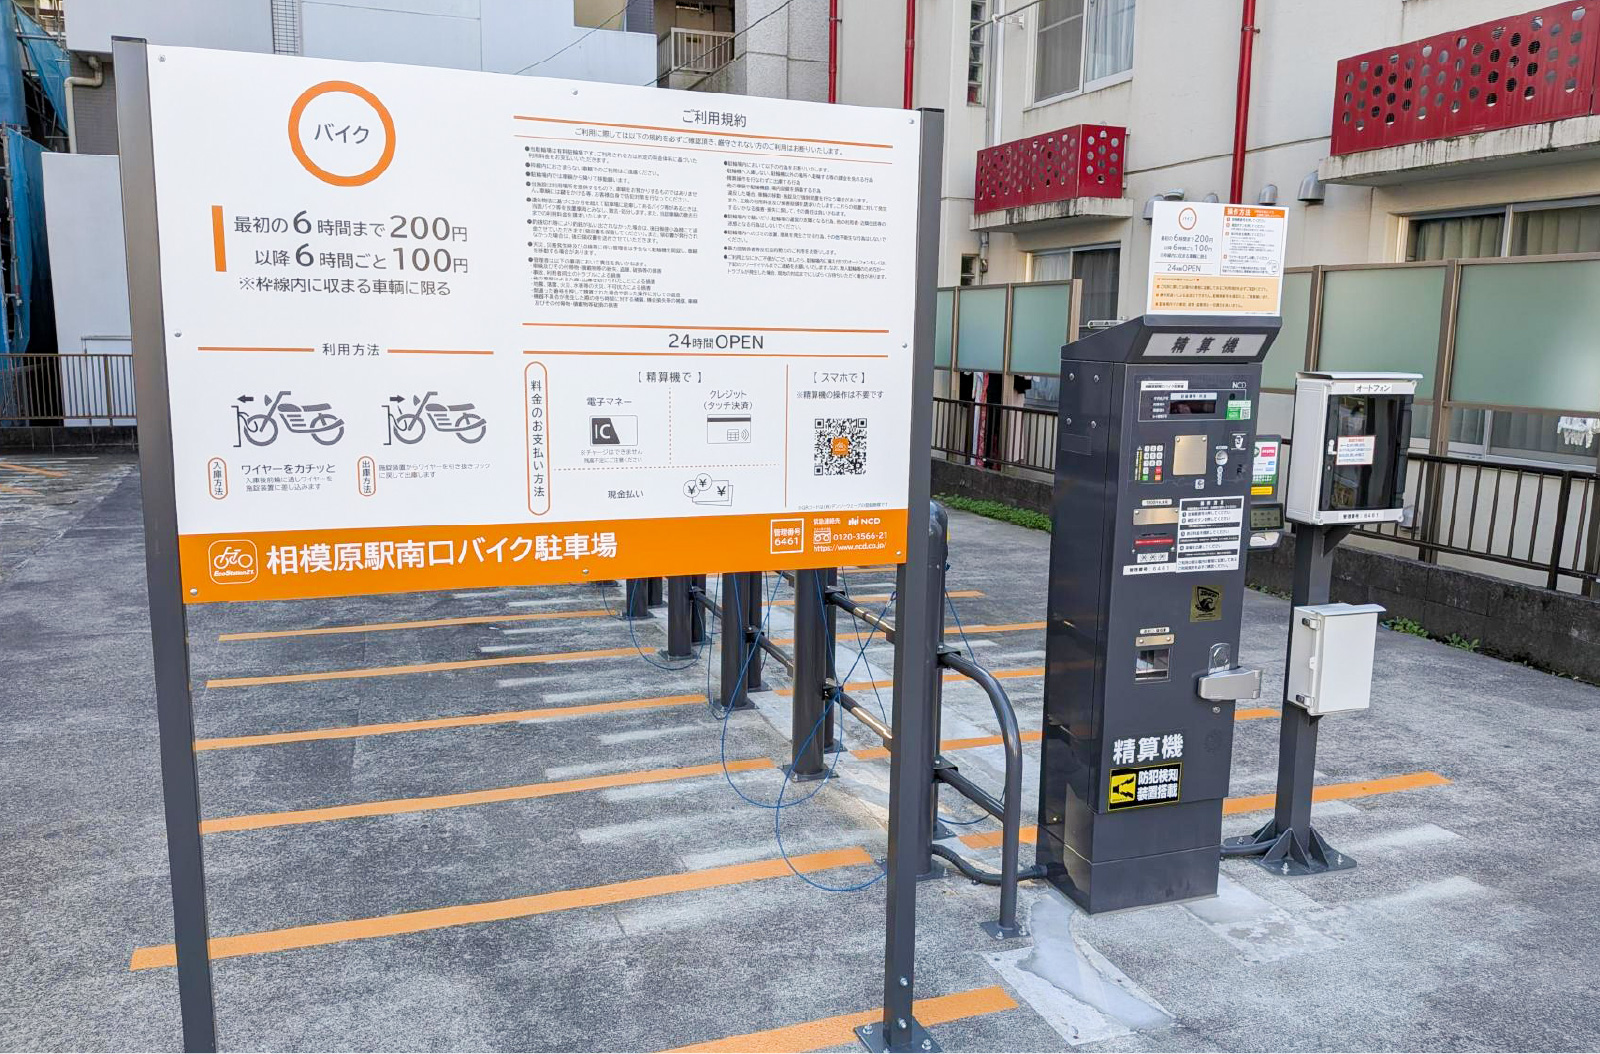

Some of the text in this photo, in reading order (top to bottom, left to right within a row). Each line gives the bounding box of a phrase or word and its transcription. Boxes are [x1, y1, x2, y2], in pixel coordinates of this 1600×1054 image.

[682, 109, 747, 128] ご利用規約
[314, 122, 370, 145] バイク
[233, 209, 468, 242] 最初の6時間まで200円
[254, 243, 469, 274] 以降6時間ごと100円
[321, 343, 380, 357] 利用方法
[668, 333, 764, 350] 24時間OPEN
[1171, 336, 1240, 354] 精算機
[709, 389, 747, 400] クレジット
[1355, 384, 1391, 393] オートフォン
[586, 396, 632, 407] 電子マネー
[530, 379, 545, 498] 料金のお支払い方法
[241, 464, 336, 475] ワイヤーをカチッと
[361, 460, 373, 495] 出庫方法
[212, 461, 224, 497] 入庫方法
[608, 489, 644, 499] 現金払い
[861, 517, 881, 525] NCD
[773, 528, 801, 537] 管理番号
[774, 537, 799, 546] 6461
[266, 531, 618, 575] 相模原駅南口バイク駐車場
[1112, 733, 1184, 765] 精算機
[1138, 768, 1179, 786] 防犯検知
[1136, 784, 1178, 802] 装置搭載
